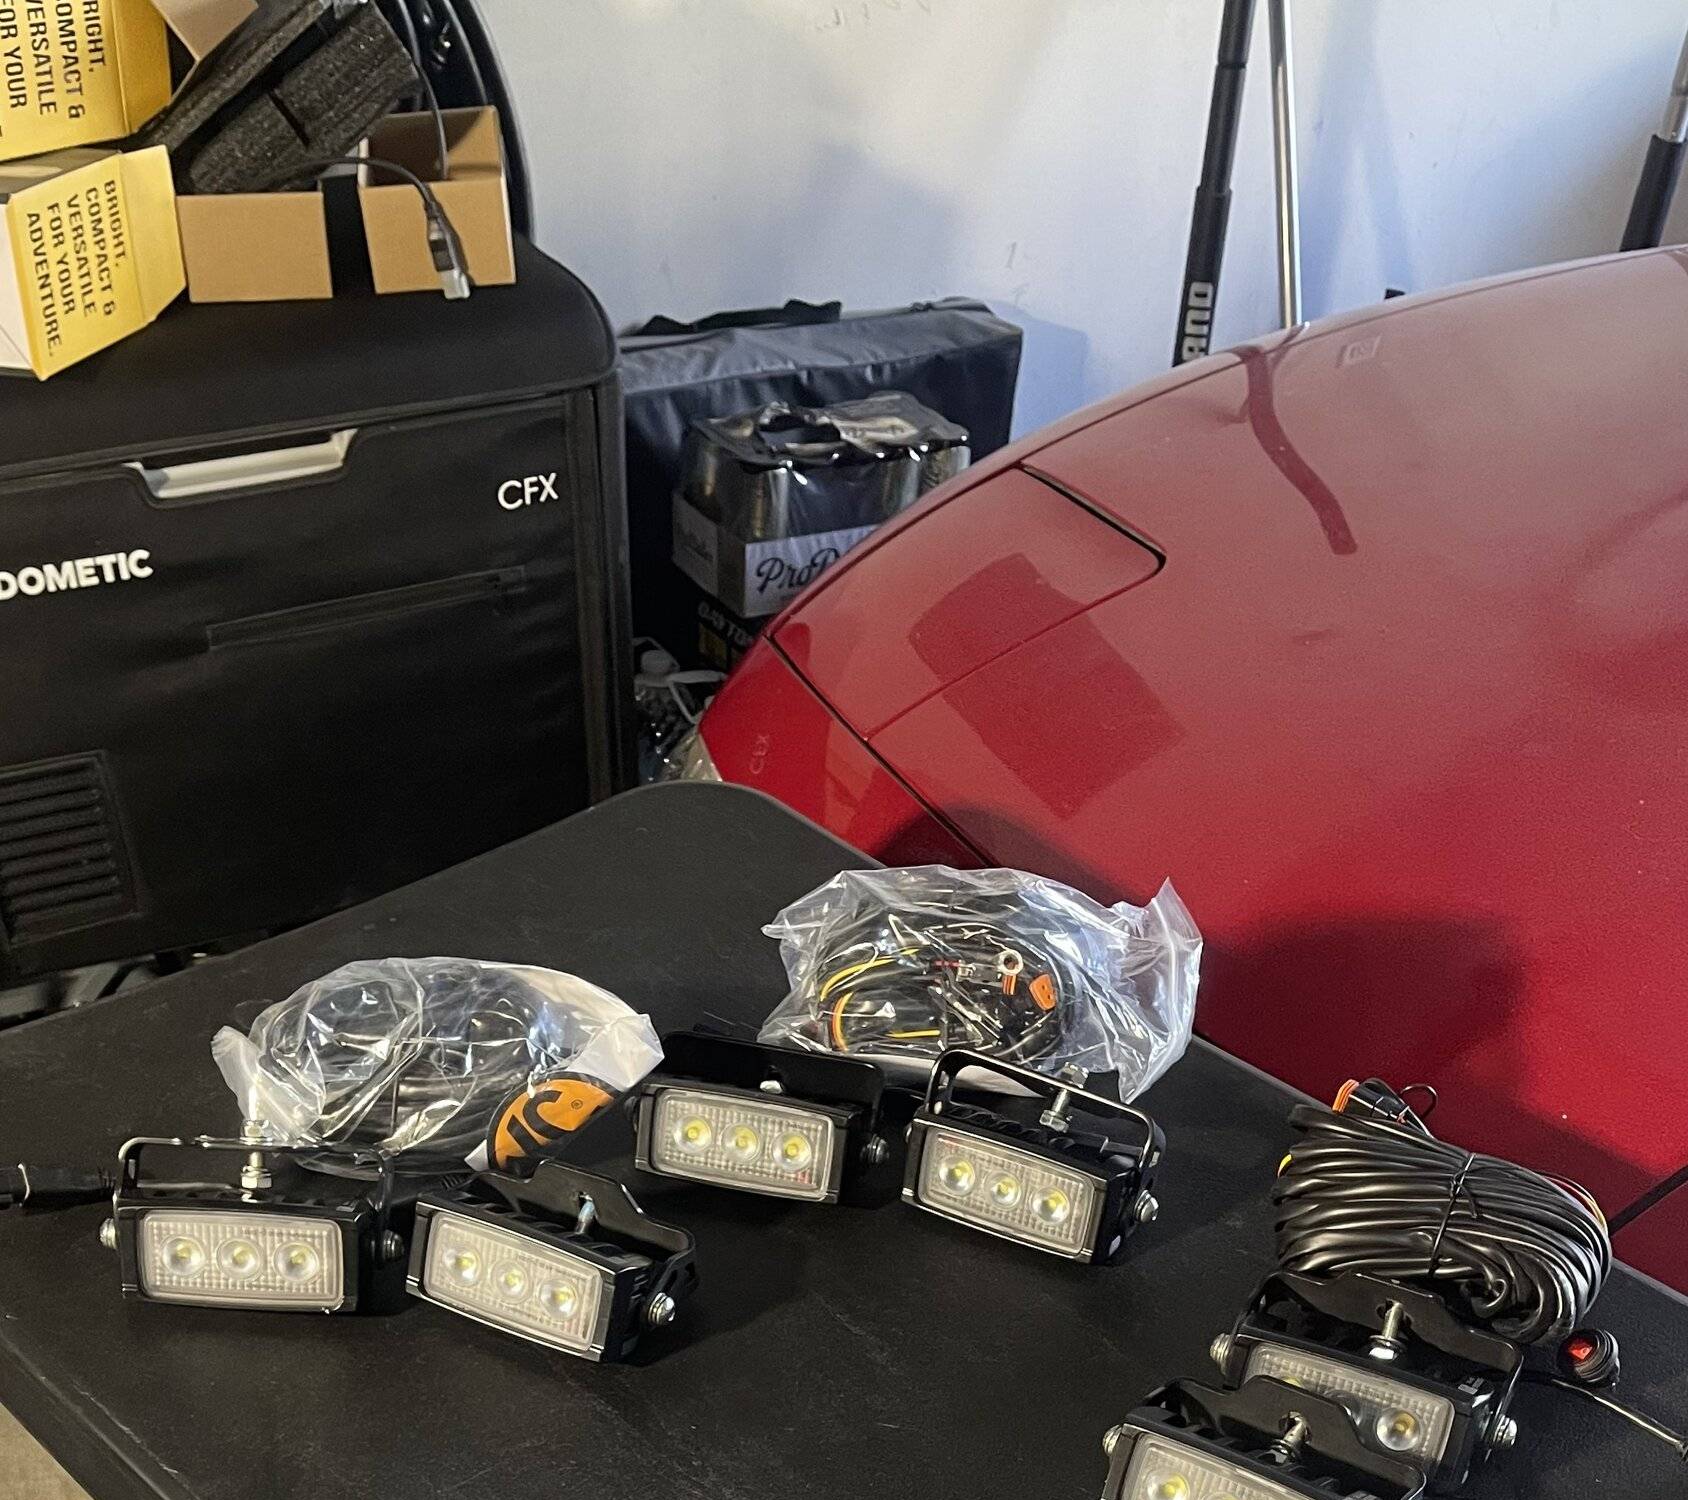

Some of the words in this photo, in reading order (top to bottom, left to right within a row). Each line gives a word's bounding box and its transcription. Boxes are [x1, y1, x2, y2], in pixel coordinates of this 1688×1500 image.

[55, 0, 83, 96] OMPACT
[82, 0, 107, 72] RIGHT.
[3, 46, 28, 108] YOUR
[47, 202, 66, 248] FOR
[67, 193, 97, 318] VERSATILE
[86, 187, 114, 293] COMPACT
[104, 179, 126, 267] BRIGHT.
[27, 212, 62, 357] ADVENTURE.
[56, 252, 76, 315] YOUR
[497, 472, 559, 511] CFX
[0, 549, 154, 601] DOMETIC
